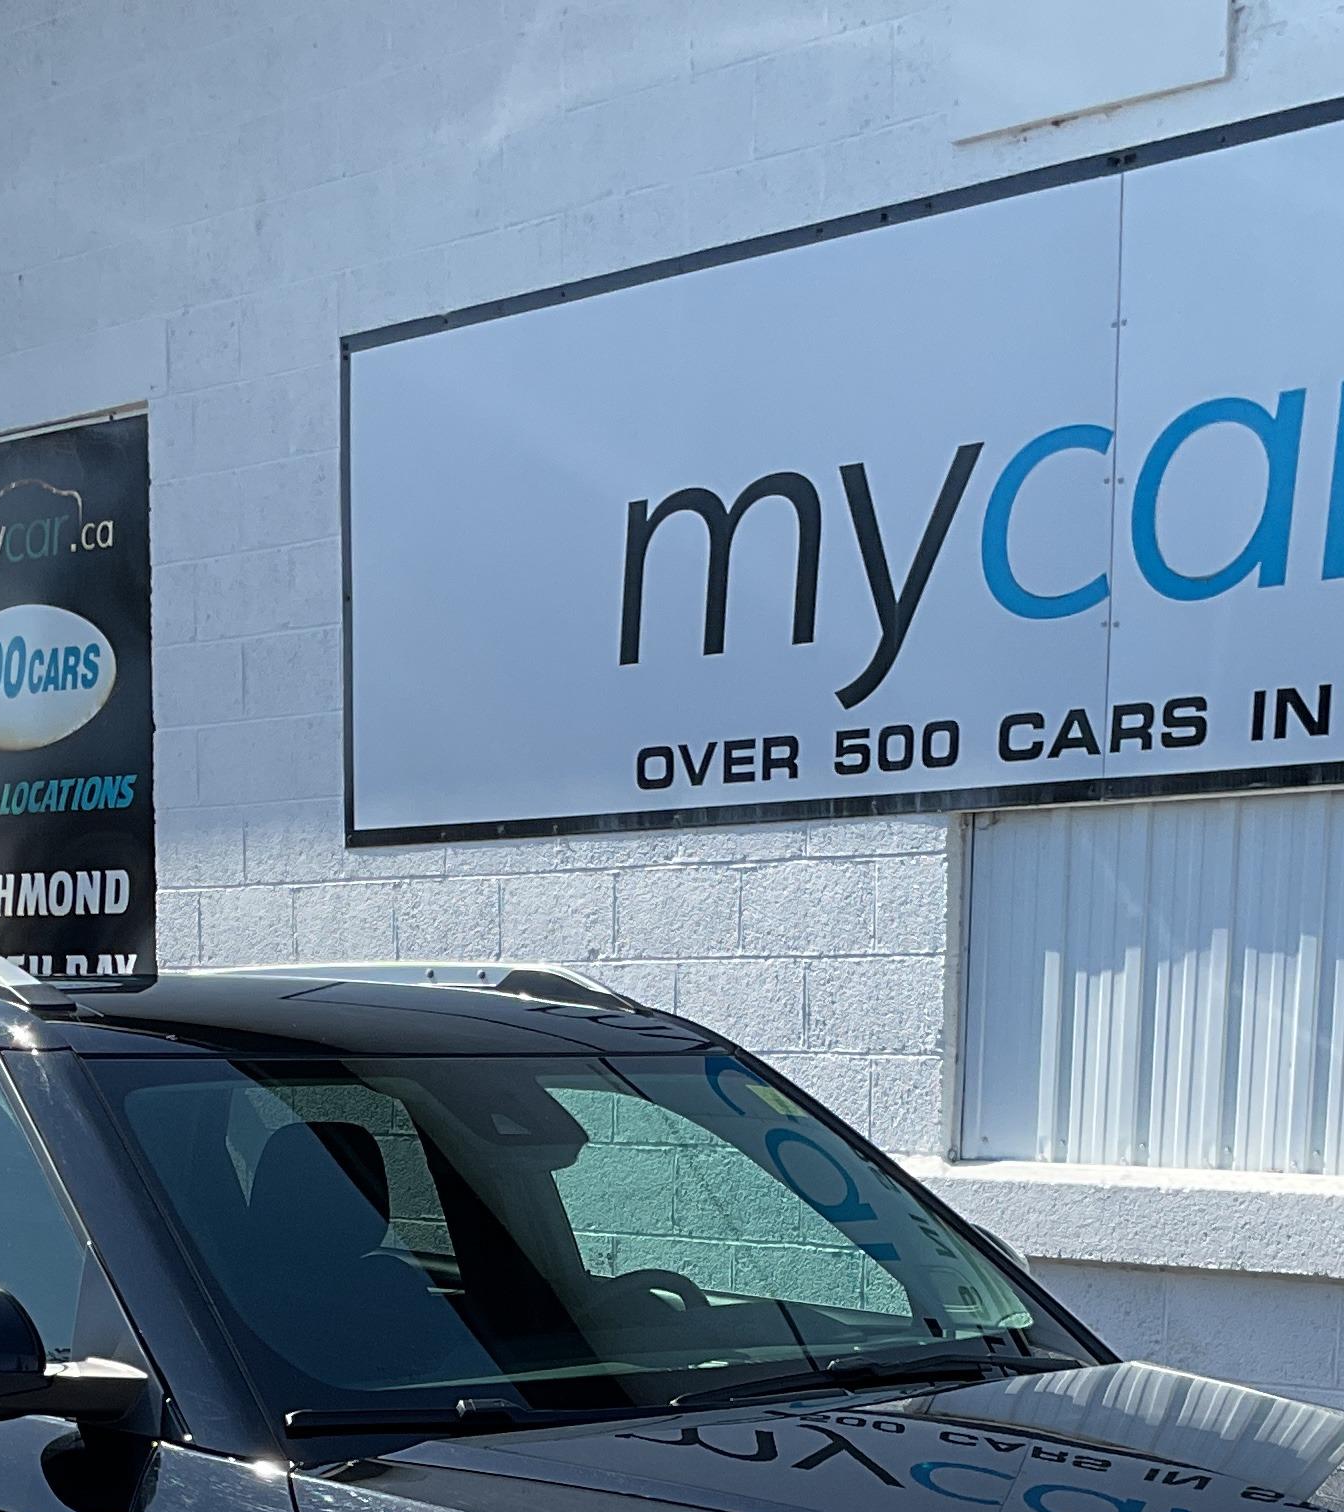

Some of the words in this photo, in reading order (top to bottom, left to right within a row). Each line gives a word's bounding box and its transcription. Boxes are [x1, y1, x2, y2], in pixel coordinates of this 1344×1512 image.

[635, 734, 801, 792] OVER
[832, 718, 961, 777] 500
[997, 694, 1209, 764] CARS
[1248, 682, 1334, 743] IN
[0, 774, 138, 816] LOCATIONS
